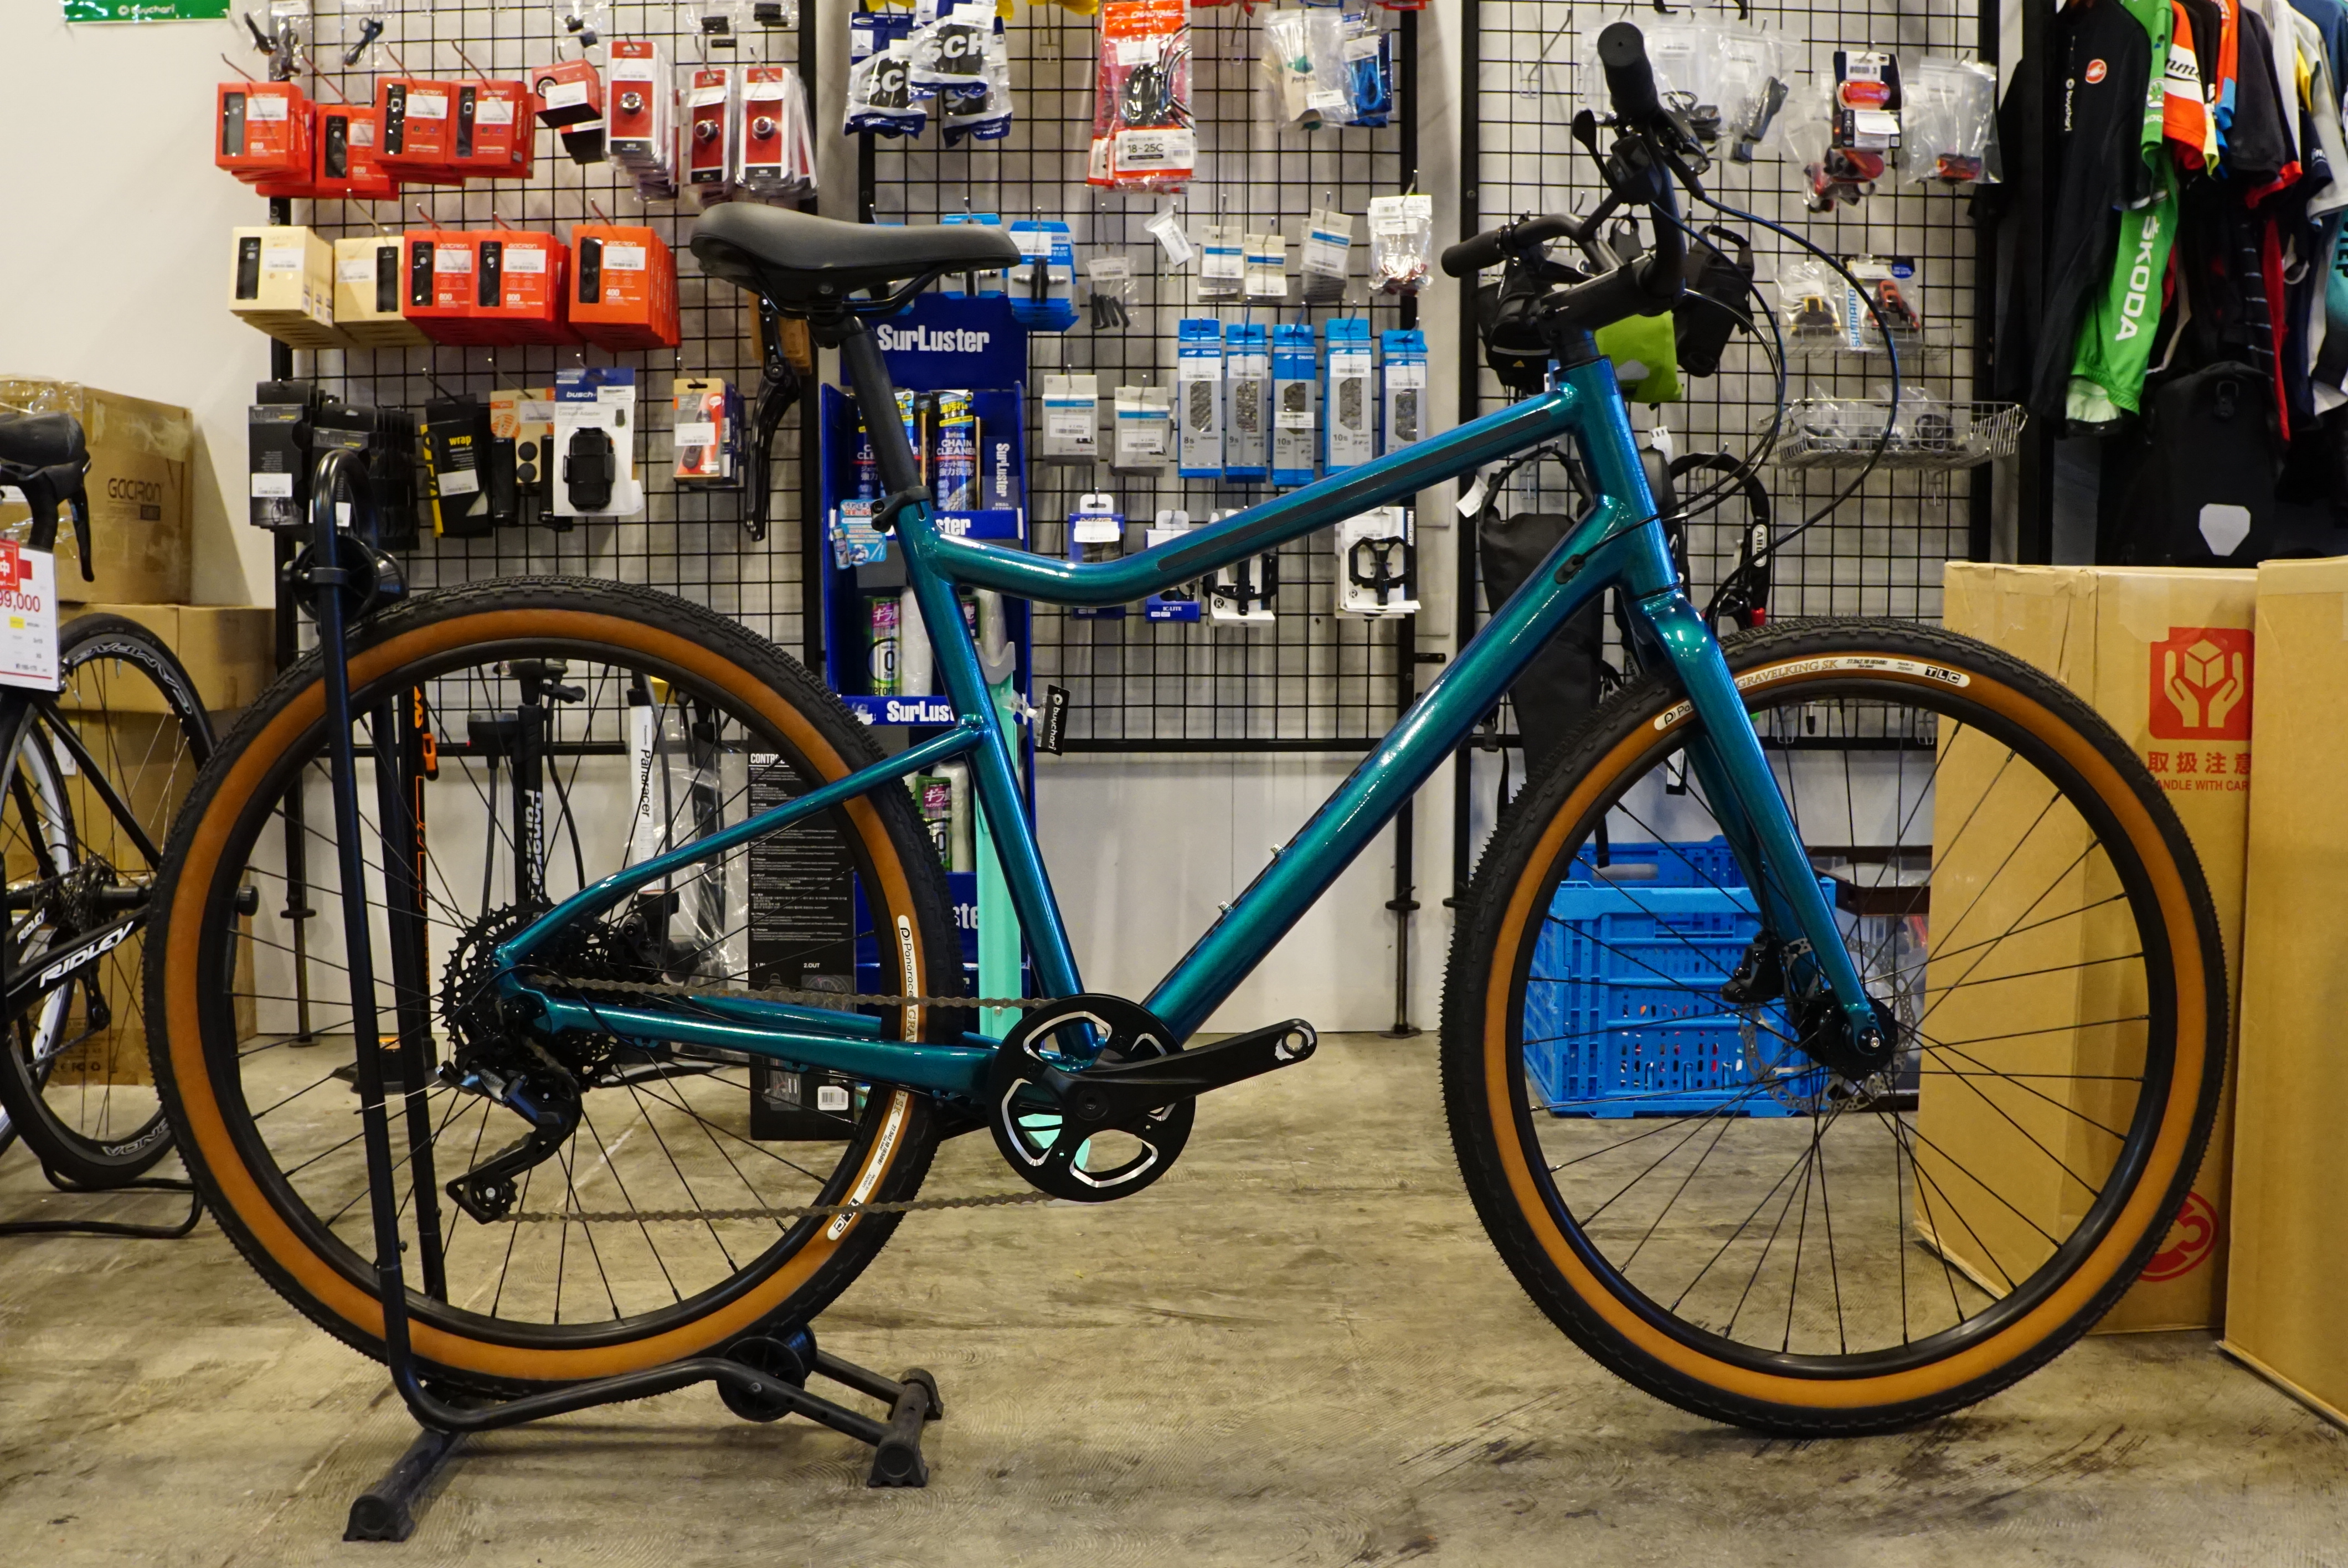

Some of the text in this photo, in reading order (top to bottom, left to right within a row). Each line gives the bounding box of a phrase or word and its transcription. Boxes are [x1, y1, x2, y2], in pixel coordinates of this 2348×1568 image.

[1127, 143, 1164, 153] 18-25C
[2115, 215, 2160, 341] ŠKODA
[1848, 288, 1861, 348] SHIMANO
[877, 324, 990, 352] SurLuster
[449, 436, 472, 446] wrap
[941, 439, 972, 447] CHAIN
[996, 443, 1010, 497] SurLuster
[1736, 659, 1839, 688] GRAVELKING SK
[1925, 666, 1961, 684] TLC
[887, 700, 955, 723] SurLus
[1048, 706, 1060, 751] buychari
[750, 753, 785, 764] CONTR
[2147, 751, 2252, 775] 取扱注意
[640, 749, 651, 818] Panaracer
[2156, 780, 2250, 791] ANDLE WITH CAR
[39, 921, 134, 989] RIDLEY
[903, 943, 914, 997] Panarace
